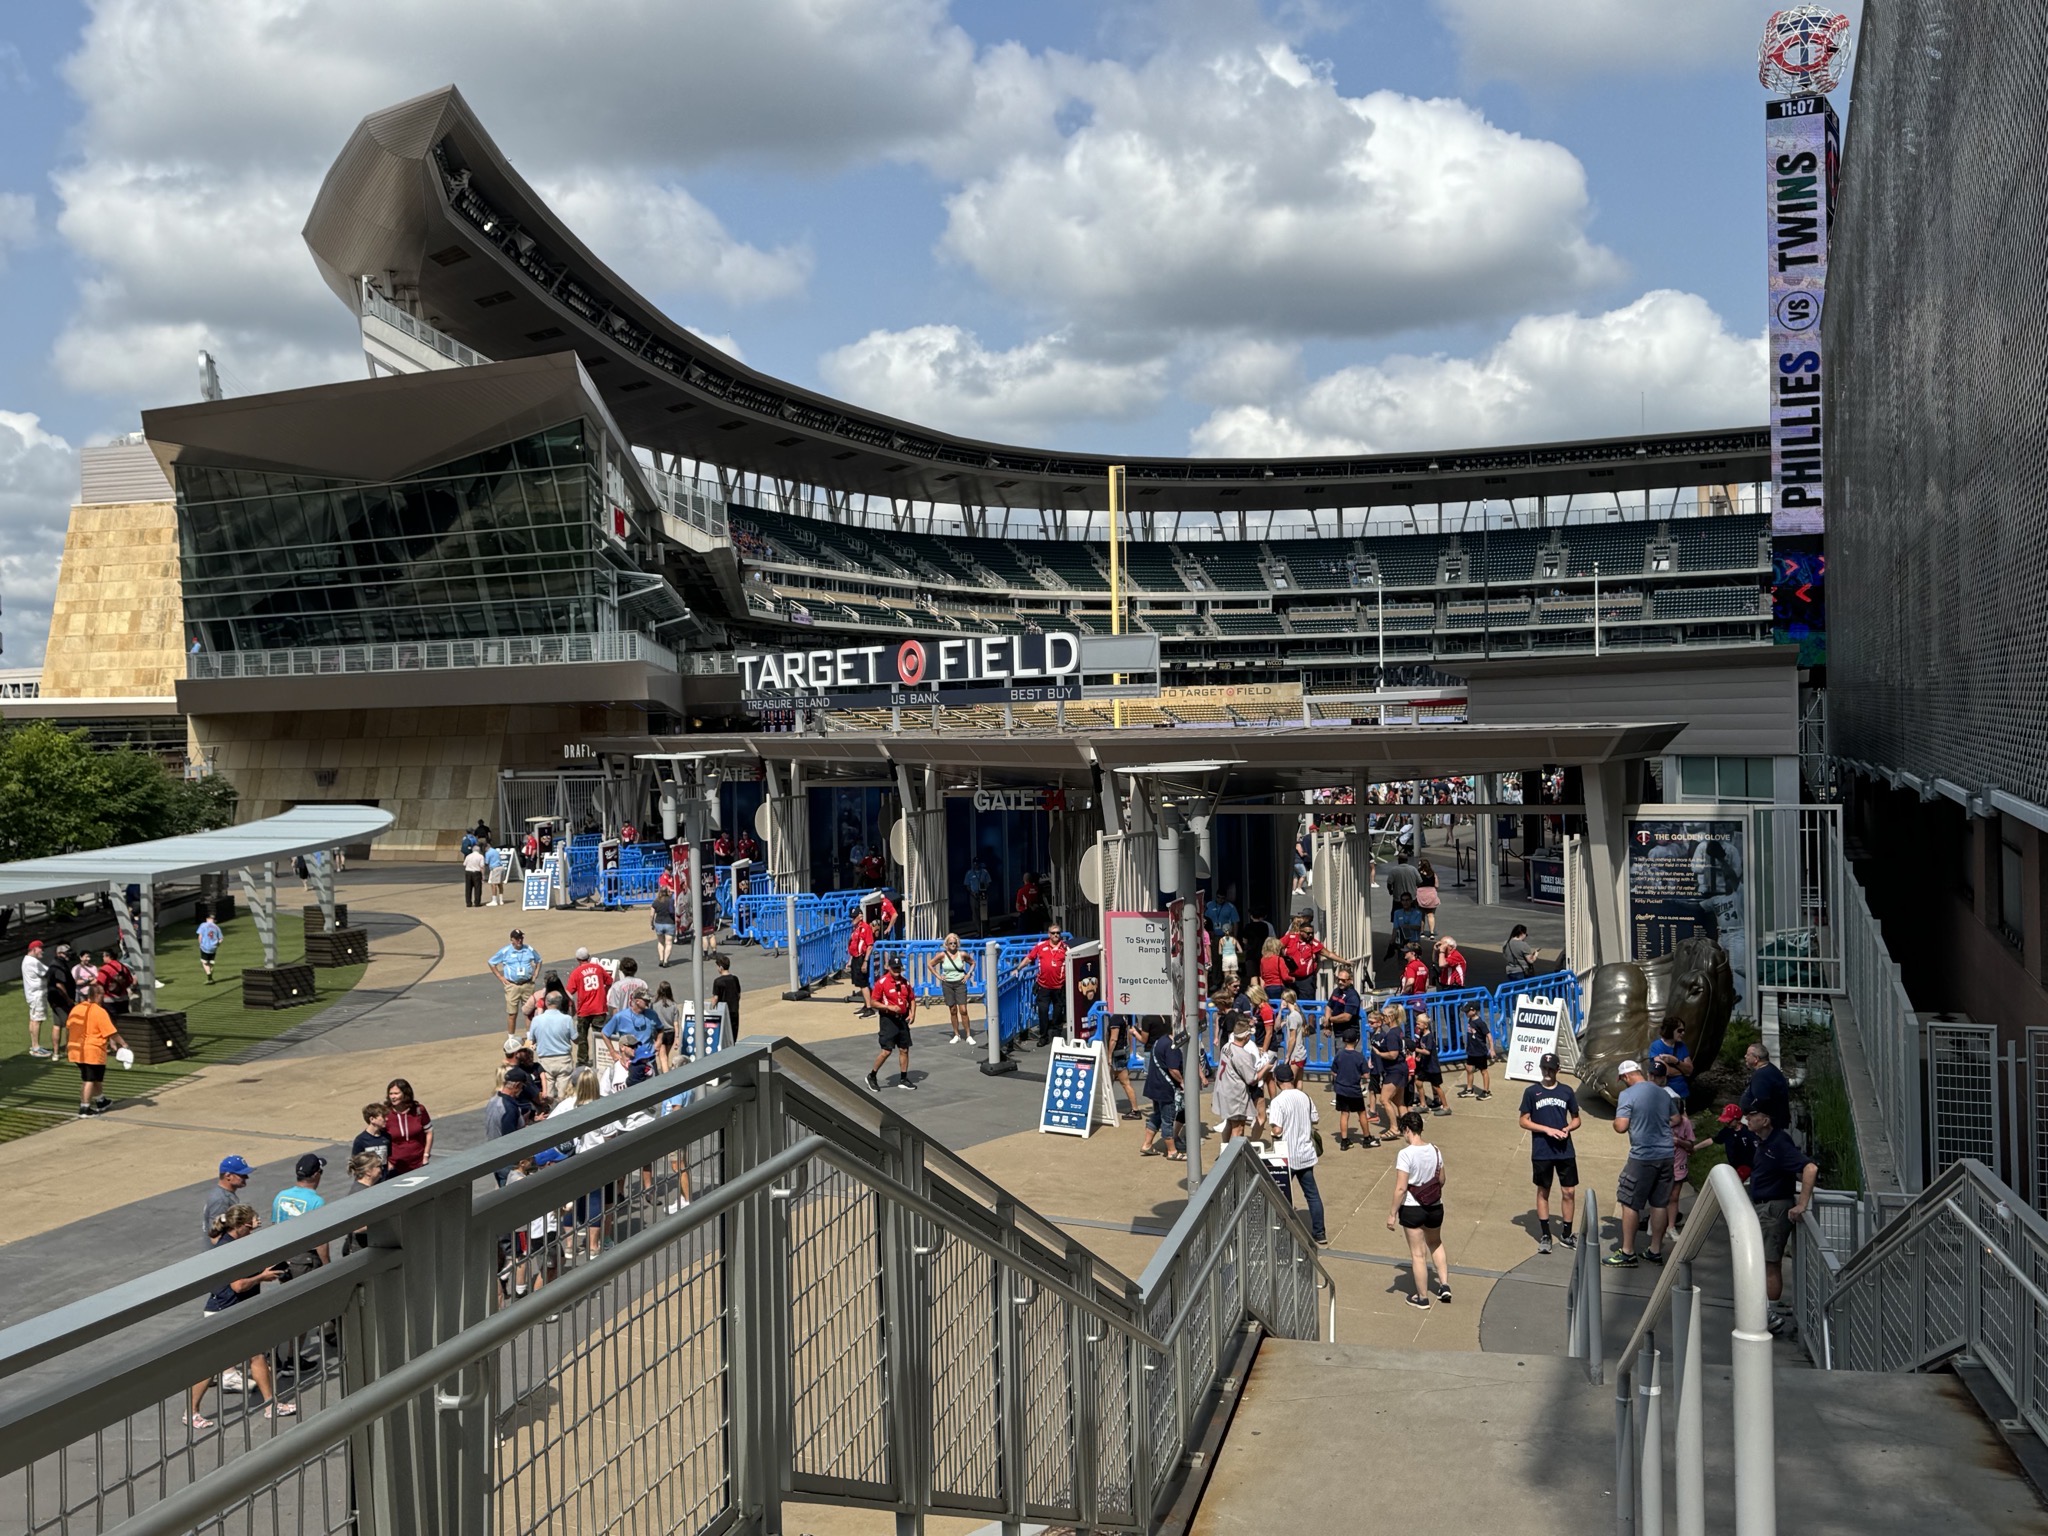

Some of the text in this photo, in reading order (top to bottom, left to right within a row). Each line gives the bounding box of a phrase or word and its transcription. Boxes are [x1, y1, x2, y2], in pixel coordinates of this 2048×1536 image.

[1780, 99, 1815, 117] 11:07
[1776, 151, 1819, 272] TWINS
[1787, 298, 1810, 322] VS
[1779, 350, 1823, 508] PHILLIES
[737, 632, 1080, 690] TARGET FIELD
[891, 693, 940, 704] US BANK
[1010, 687, 1074, 700] BEST BUY
[1161, 687, 1272, 698] TO TARGET FIELD
[747, 697, 831, 710] TREASURE ISLAND
[973, 789, 1066, 811] GATE 34
[1654, 833, 1731, 841] THE GOLDEN GLOVE
[1540, 875, 1555, 884] TICKET
[1724, 910, 1738, 921] 34
[1136, 937, 1166, 945] Skyway
[1138, 946, 1160, 954] Ramp
[583, 974, 600, 992] 29
[1118, 976, 1169, 986] Target Center
[1519, 1012, 1556, 1026] CAUTION!
[1517, 1034, 1551, 1046] GLOVE MAY
[1520, 1045, 1543, 1054] BE HOT!
[1219, 1060, 1227, 1081] 7
[1535, 1097, 1568, 1110] MINNESOTA
